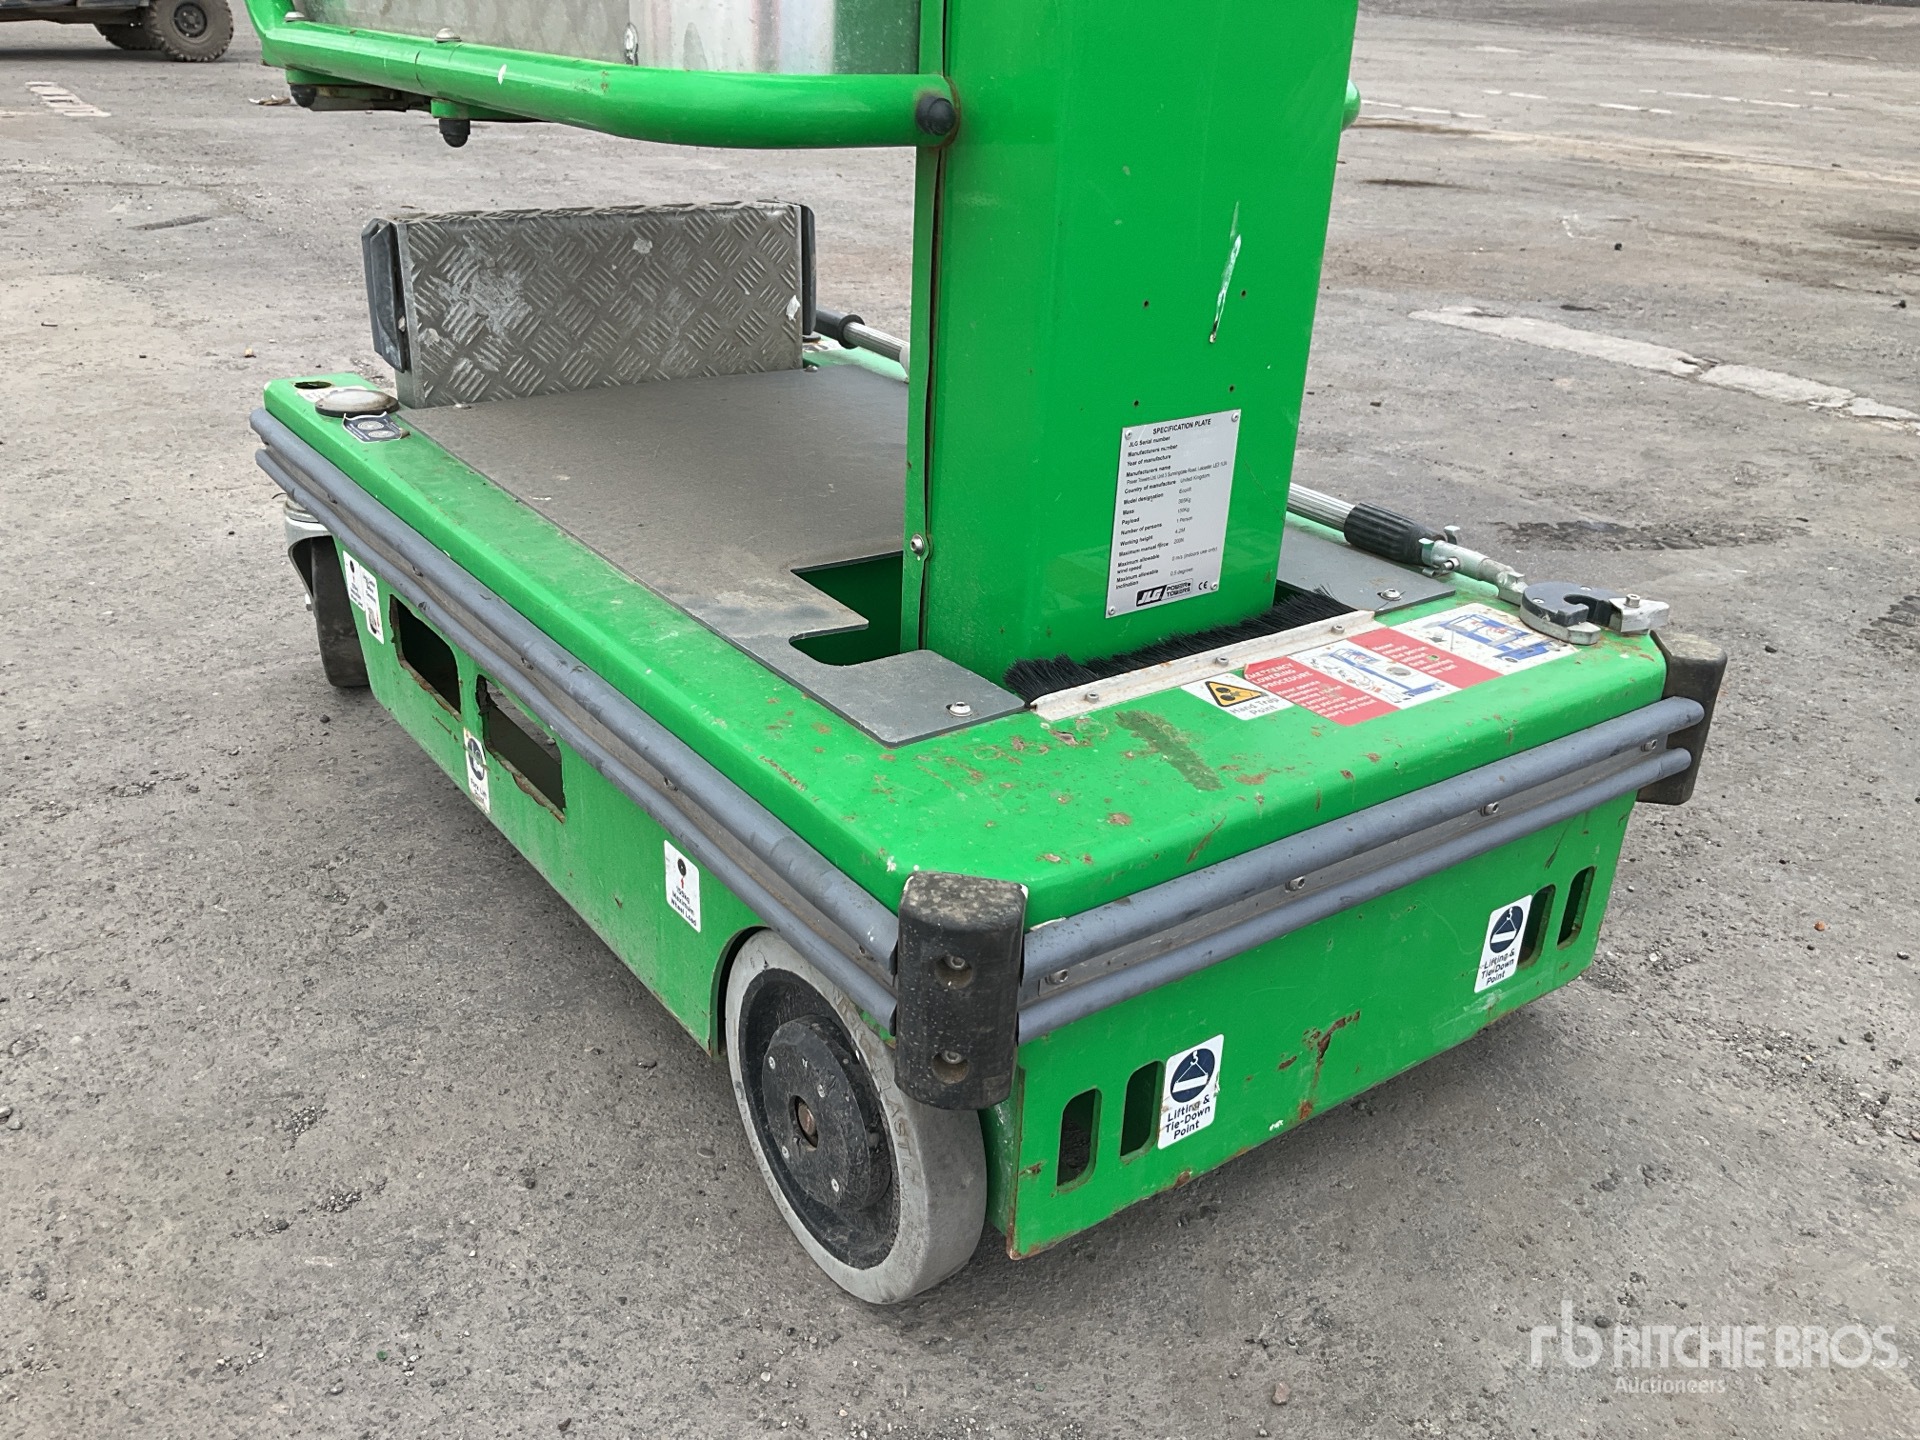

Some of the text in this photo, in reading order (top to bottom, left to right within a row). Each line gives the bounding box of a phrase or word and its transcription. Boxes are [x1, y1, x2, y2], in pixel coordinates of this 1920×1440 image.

[1152, 418, 1212, 435] SPECIFICATION PLATE
[1128, 435, 1171, 448] JLG Serial number
[1127, 444, 1178, 458] Manufacturers number
[1126, 459, 1137, 467] Year
[1144, 454, 1172, 464] manufacture
[1126, 464, 1172, 478] Manufacturers name
[1193, 473, 1211, 481] Kingdom
[1124, 486, 1142, 494] Country
[1149, 480, 1177, 490] manufacture
[1124, 492, 1164, 505] Model designation
[1122, 517, 1140, 526] Payload
[1120, 528, 1138, 536] Number
[1144, 523, 1162, 532] persons
[1120, 534, 1154, 547] Working height
[1118, 548, 1140, 557] Maximum
[1140, 544, 1156, 552] manual
[1118, 554, 1160, 568] Maximum allowable
[1128, 564, 1142, 573] speed
[1116, 569, 1159, 583] Maximum allowable
[1137, 587, 1162, 605] JLG
[1252, 669, 1296, 684] LOWERING
[1261, 671, 1314, 690] PROCEDURE
[1230, 698, 1280, 714] Hand Trap
[1250, 705, 1278, 715] Point
[1484, 948, 1515, 969] Lifting &
[1486, 971, 1506, 986] Point
[1167, 1094, 1210, 1122] Lifting &
[1165, 1106, 1210, 1133] Tie-Down
[1174, 1120, 1200, 1140] Point
